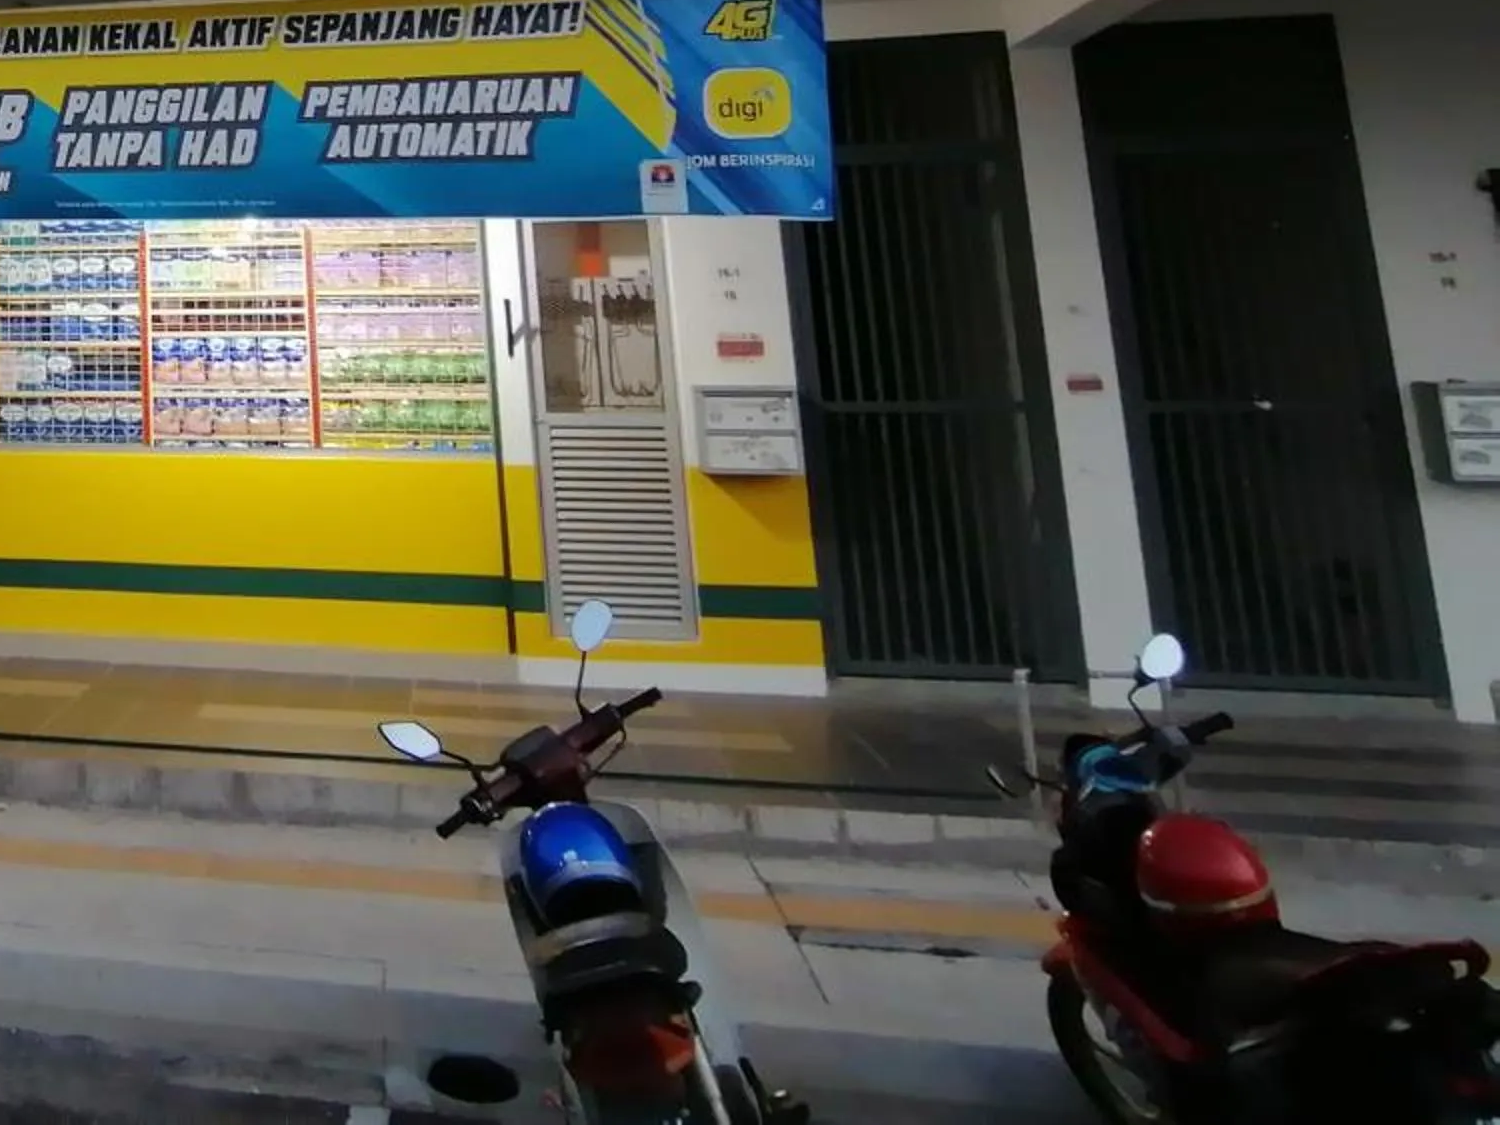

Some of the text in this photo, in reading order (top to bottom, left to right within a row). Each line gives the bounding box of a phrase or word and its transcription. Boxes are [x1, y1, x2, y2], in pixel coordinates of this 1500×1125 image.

[88, 21, 177, 53] KEKAL
[187, 15, 275, 48] AKTIF
[283, 6, 462, 44] SEPANJANG
[470, 1, 581, 37] HAYAT!
[62, 85, 268, 128] PANGGILAN
[302, 76, 575, 119] PEMBAHARUAN
[718, 97, 764, 122] digi
[54, 127, 259, 168] TANPA HAD
[325, 121, 534, 159] AUTOMATIK
[686, 155, 717, 169] JOM
